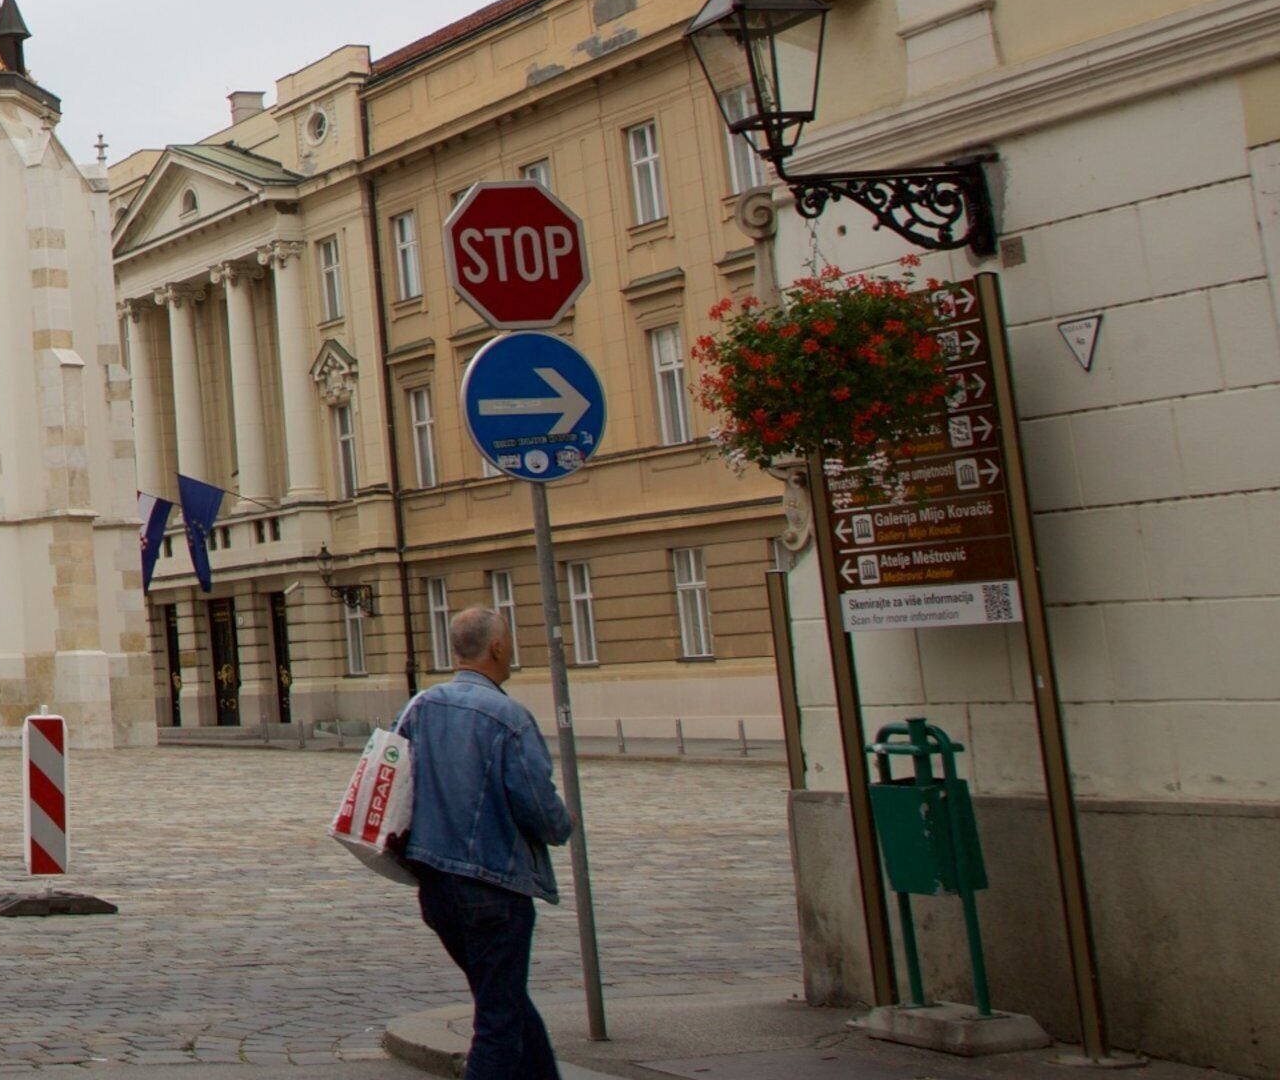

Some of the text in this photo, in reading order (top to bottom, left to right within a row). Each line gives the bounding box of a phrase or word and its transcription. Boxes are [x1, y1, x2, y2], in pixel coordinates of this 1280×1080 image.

[459, 225, 573, 284] STOP
[874, 498, 994, 527] Galerija Mijo Kovačić
[879, 545, 968, 569] Atelje Meštrović
[848, 589, 975, 613] Skenirajte za više informacija
[850, 608, 961, 627] Scan for more information
[368, 766, 394, 827] SPAR
